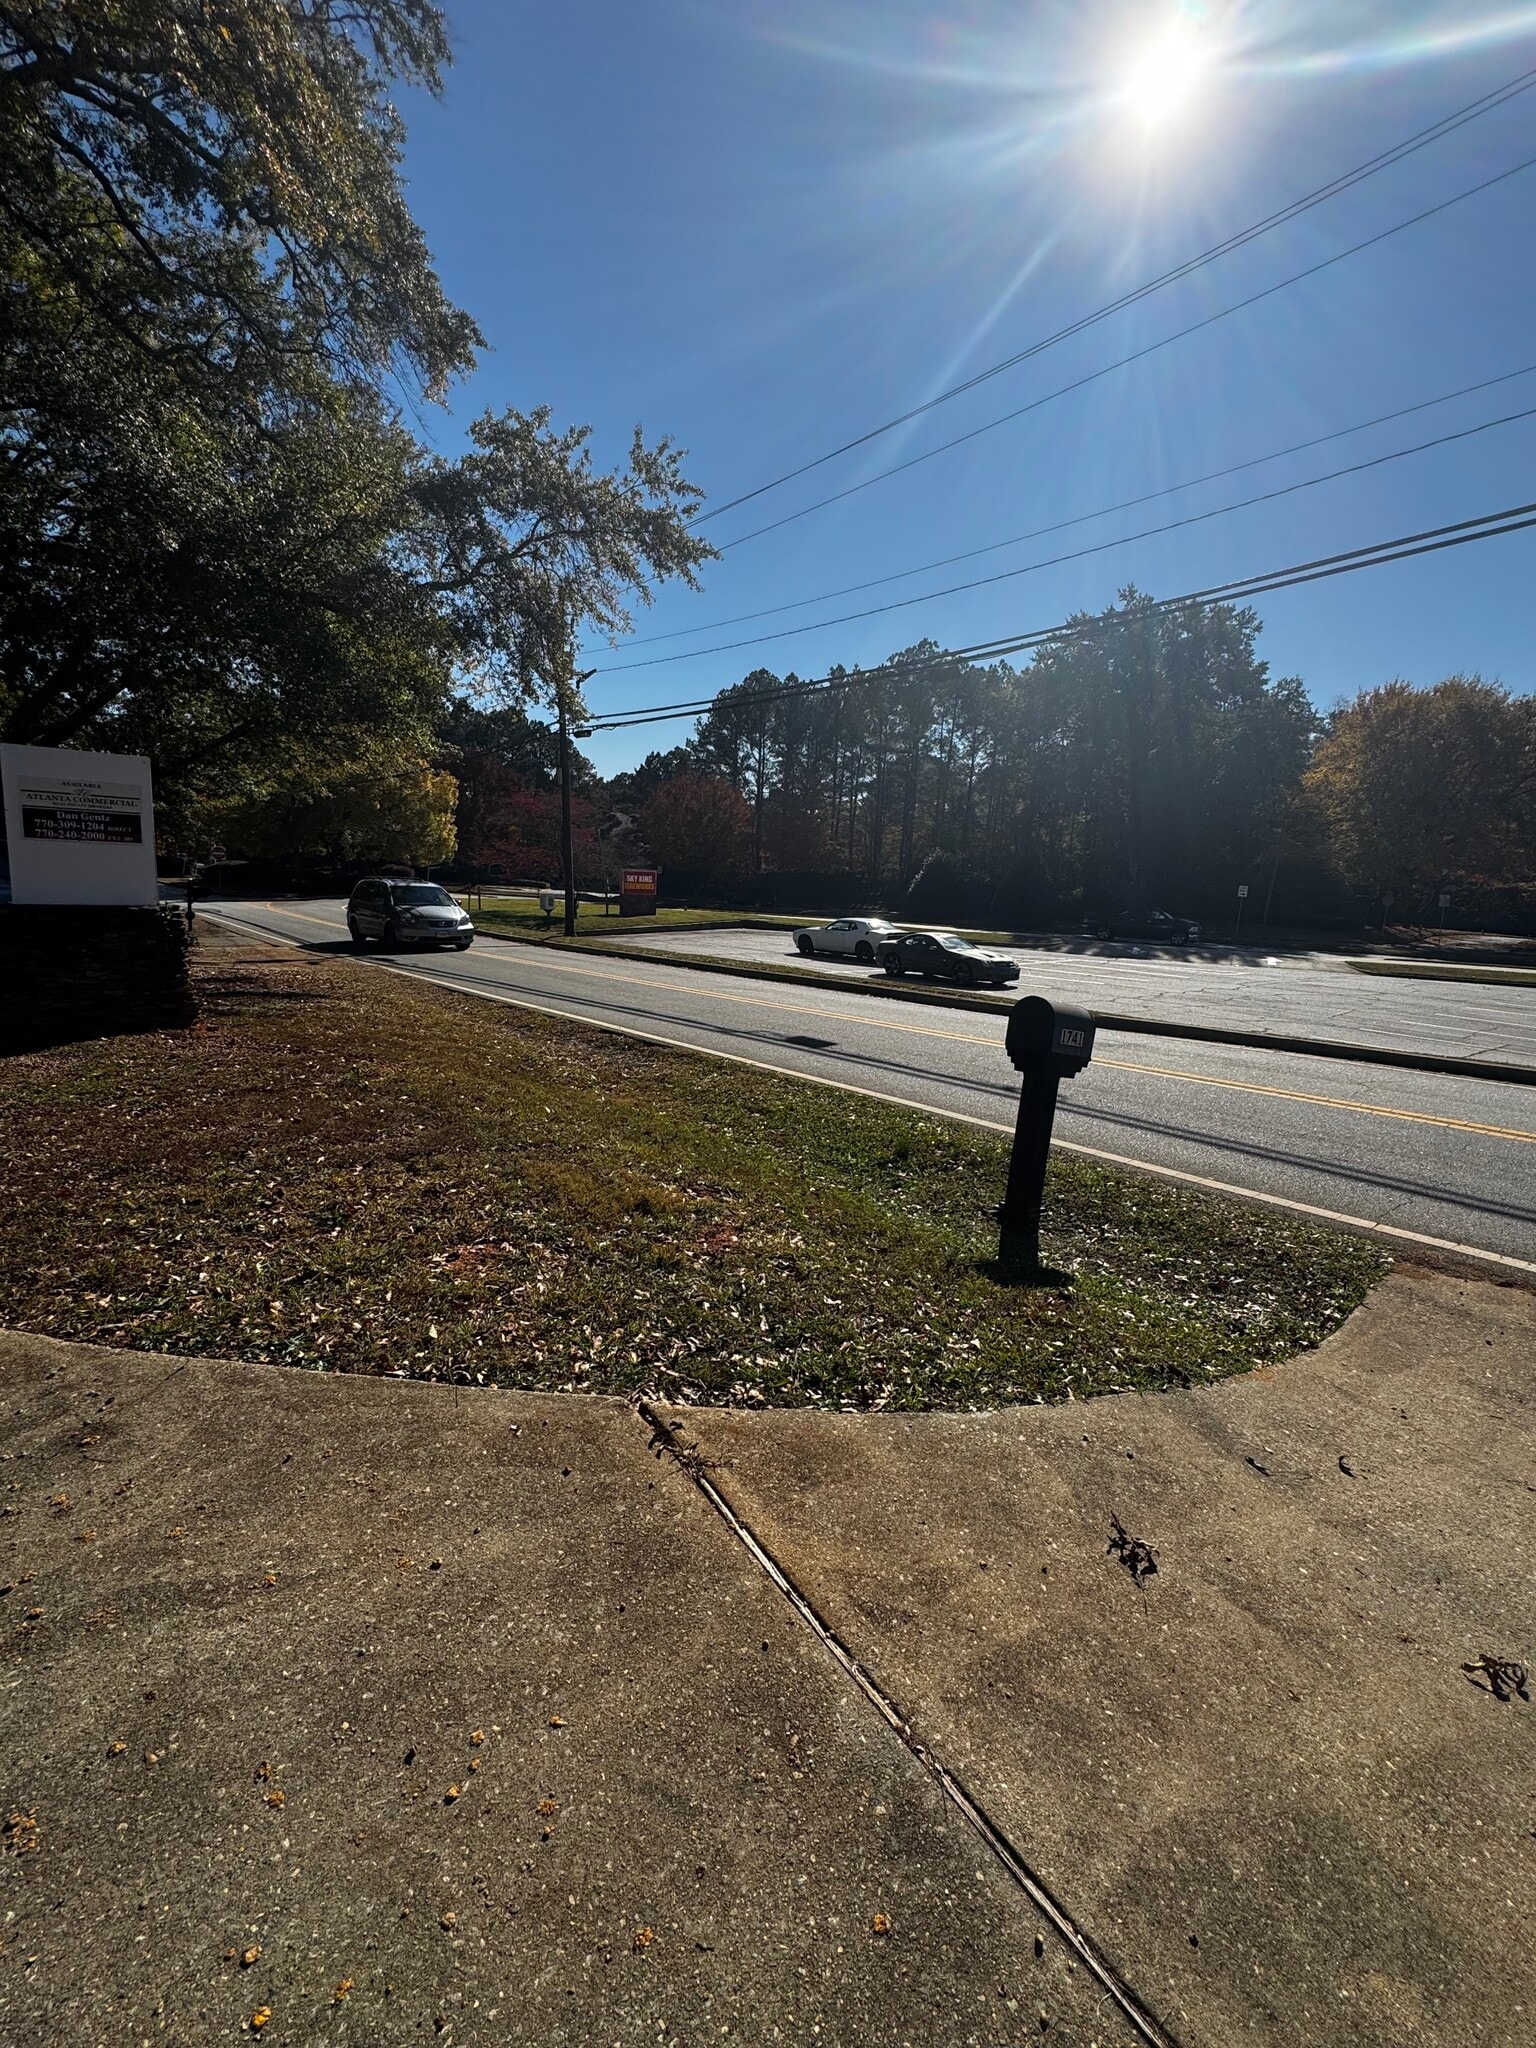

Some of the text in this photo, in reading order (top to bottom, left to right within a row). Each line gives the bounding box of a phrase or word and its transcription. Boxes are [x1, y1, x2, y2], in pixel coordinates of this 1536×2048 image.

[27, 793, 138, 807] ATLANTA COMMERCIAL
[57, 811, 112, 821] Dan Gentz
[34, 818, 104, 831] 770-309-1204
[35, 829, 105, 840] 770-240-2000
[1061, 1029, 1083, 1046] 1741
